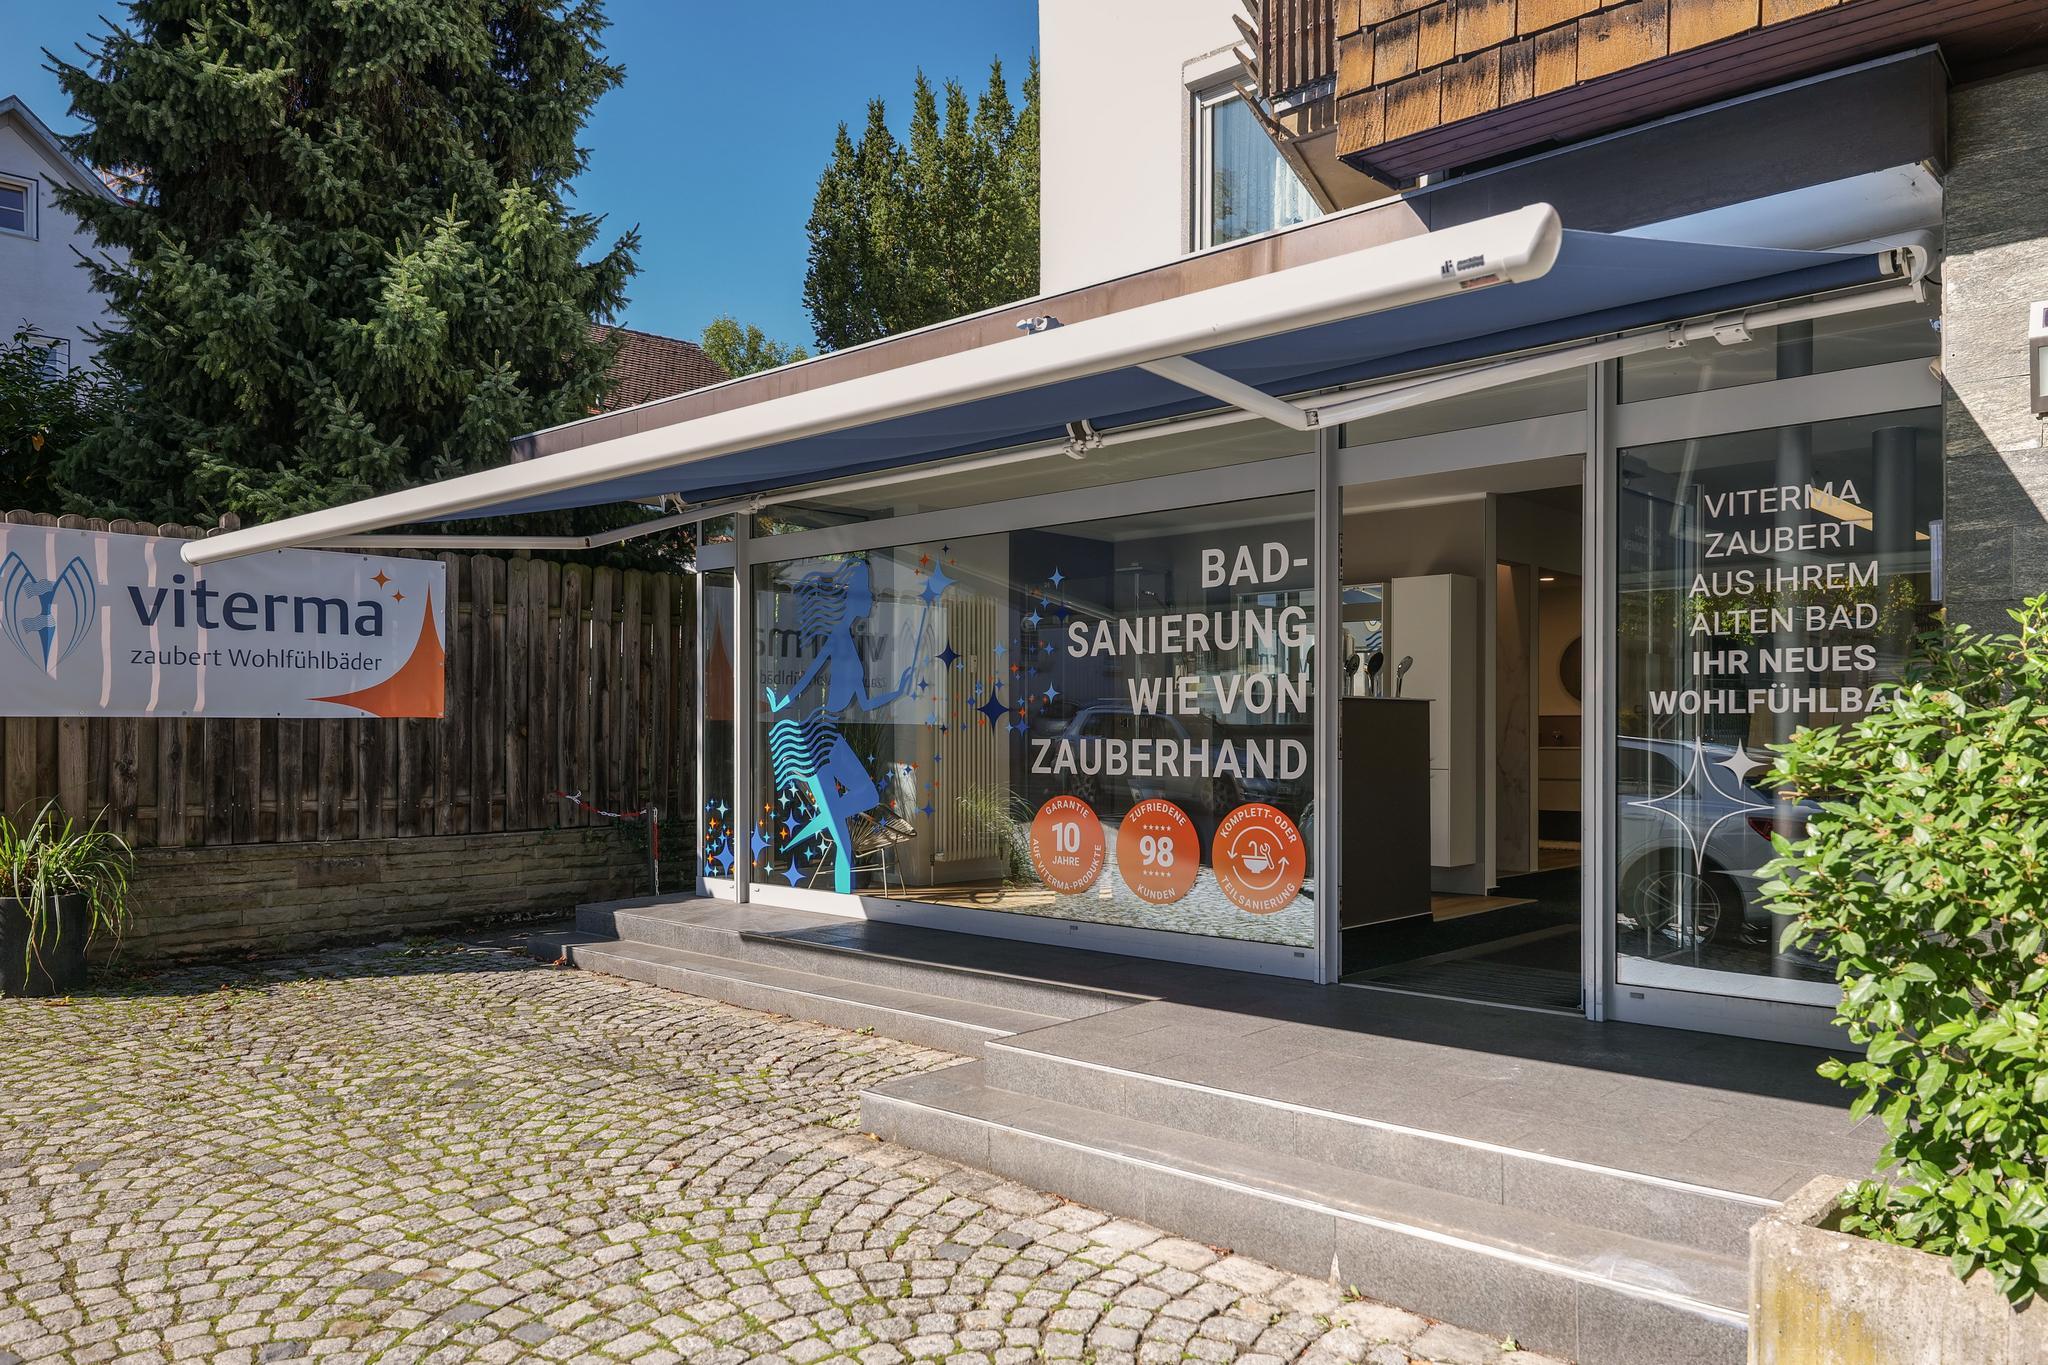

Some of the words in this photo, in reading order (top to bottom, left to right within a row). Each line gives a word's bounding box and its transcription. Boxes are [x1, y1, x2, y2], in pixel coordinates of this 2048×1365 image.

[1704, 479, 1861, 519] VITERMA
[1704, 520, 1862, 558] ZAUBERT
[1201, 542, 1308, 588] BAD-
[1688, 569, 1755, 598] AUS
[1766, 560, 1879, 593] IHREM
[127, 574, 383, 637] viterma
[1689, 606, 1793, 637] ALTEN
[1805, 603, 1878, 632] BAD
[1067, 605, 1308, 658] SANIERUNG
[130, 645, 222, 667] zaubert
[228, 648, 383, 671] Wohlfühlbäder
[1692, 650, 1749, 675] IHR
[1759, 644, 1877, 673] NEUES
[1128, 676, 1200, 715] WIE
[1213, 672, 1307, 714] VON
[1031, 738, 1308, 780] ZAUBERHAND
[1045, 800, 1090, 819] GARANTIE
[1129, 802, 1187, 826] ZUFRIEDENE
[1220, 807, 1273, 838] KOMPLETT-
[1274, 815, 1297, 844] ODER
[1051, 822, 1081, 853] 10
[1139, 835, 1174, 868] 98
[1033, 838, 1042, 859] AUF
[1038, 844, 1102, 891] VITERMA-PRODUKTE
[1052, 856, 1080, 867] JAHRE
[1137, 883, 1176, 900] KUNDEN
[1220, 875, 1296, 910] TEILSANIERUNG
